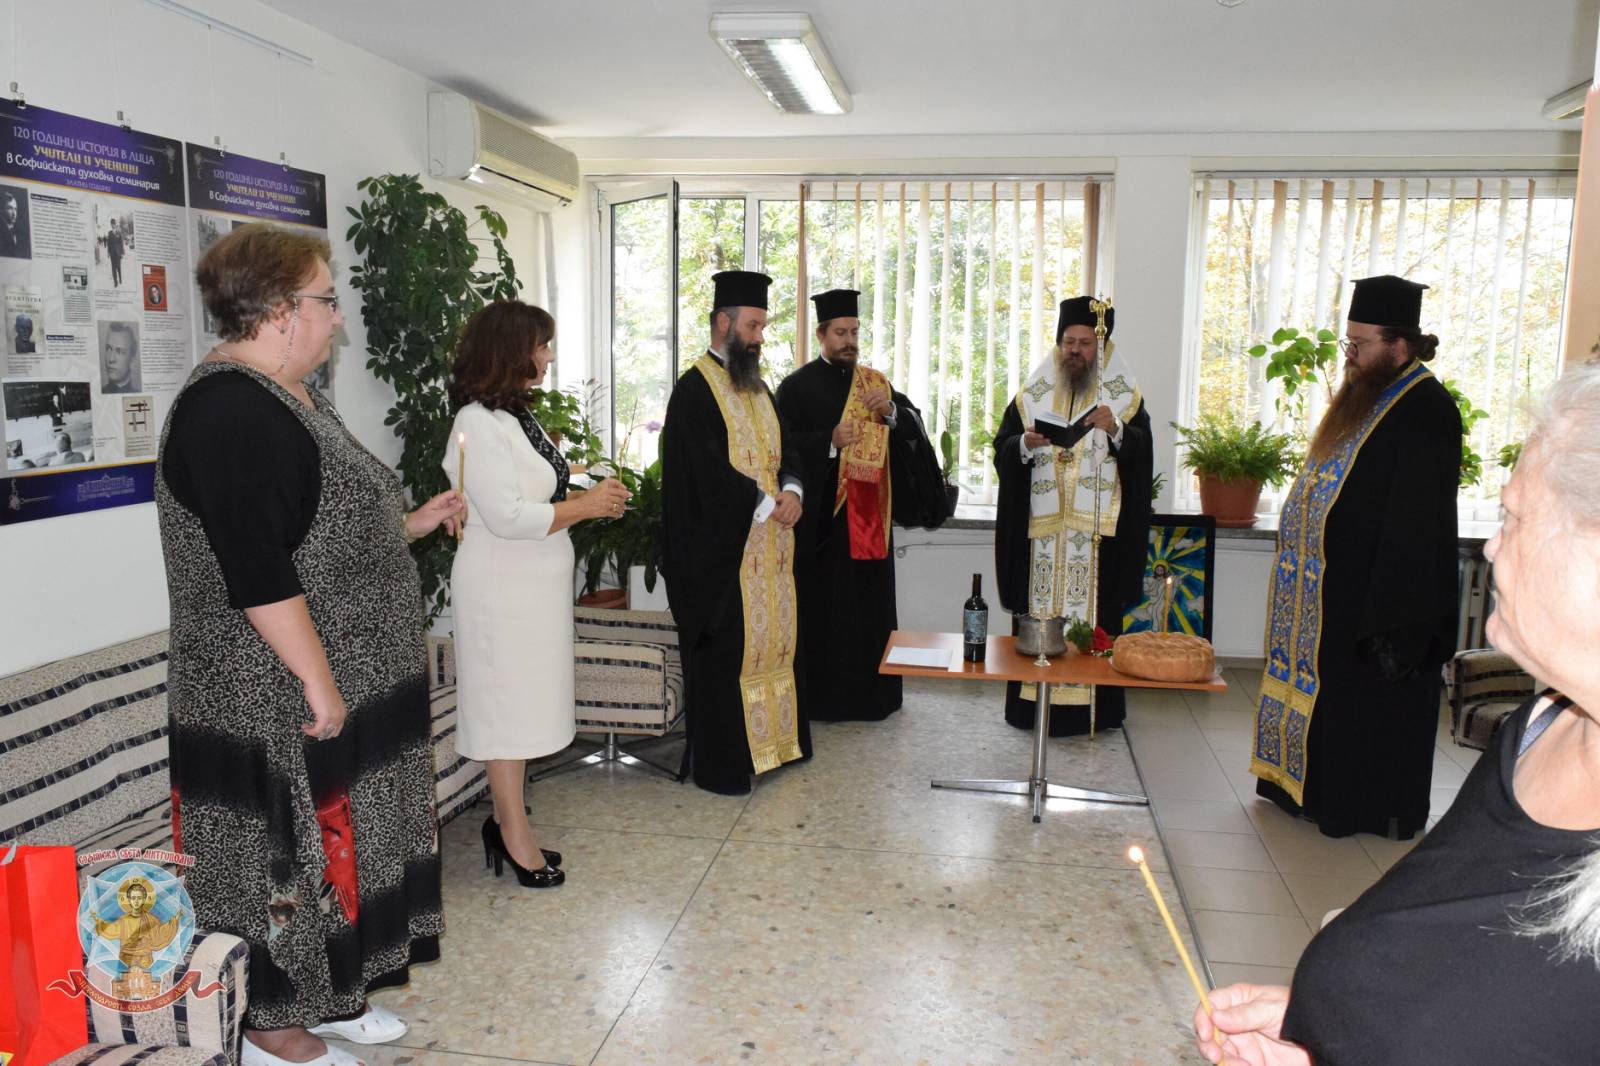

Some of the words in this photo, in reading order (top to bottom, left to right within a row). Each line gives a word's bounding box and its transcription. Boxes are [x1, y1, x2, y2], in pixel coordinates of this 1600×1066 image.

[13, 126, 30, 139] 120
[32, 129, 74, 149] ГОДИНИ
[76, 140, 119, 158] ИСТОРИЯ
[121, 149, 127, 160] В
[129, 151, 155, 166] ЛИЦА
[33, 145, 81, 163] УЧИТЕЛИ
[84, 155, 91, 166] И
[94, 156, 139, 175] УЧЕНИЦИ
[6, 152, 13, 164] В
[15, 154, 76, 175] Софийската
[78, 169, 114, 183] духовна
[115, 176, 160, 191] семинария
[213, 168, 225, 179] 120
[225, 171, 253, 184] ГОДИНИ
[254, 178, 283, 190] ИСТОРИЯ
[289, 185, 307, 195] ЛИЦА
[215, 191, 254, 207] Софийската
[256, 201, 279, 211] духовна
[280, 205, 310, 216] семинария
[226, 183, 257, 196] УЧИТЕЛИ
[266, 191, 296, 204] УЧЕНИЦИ
